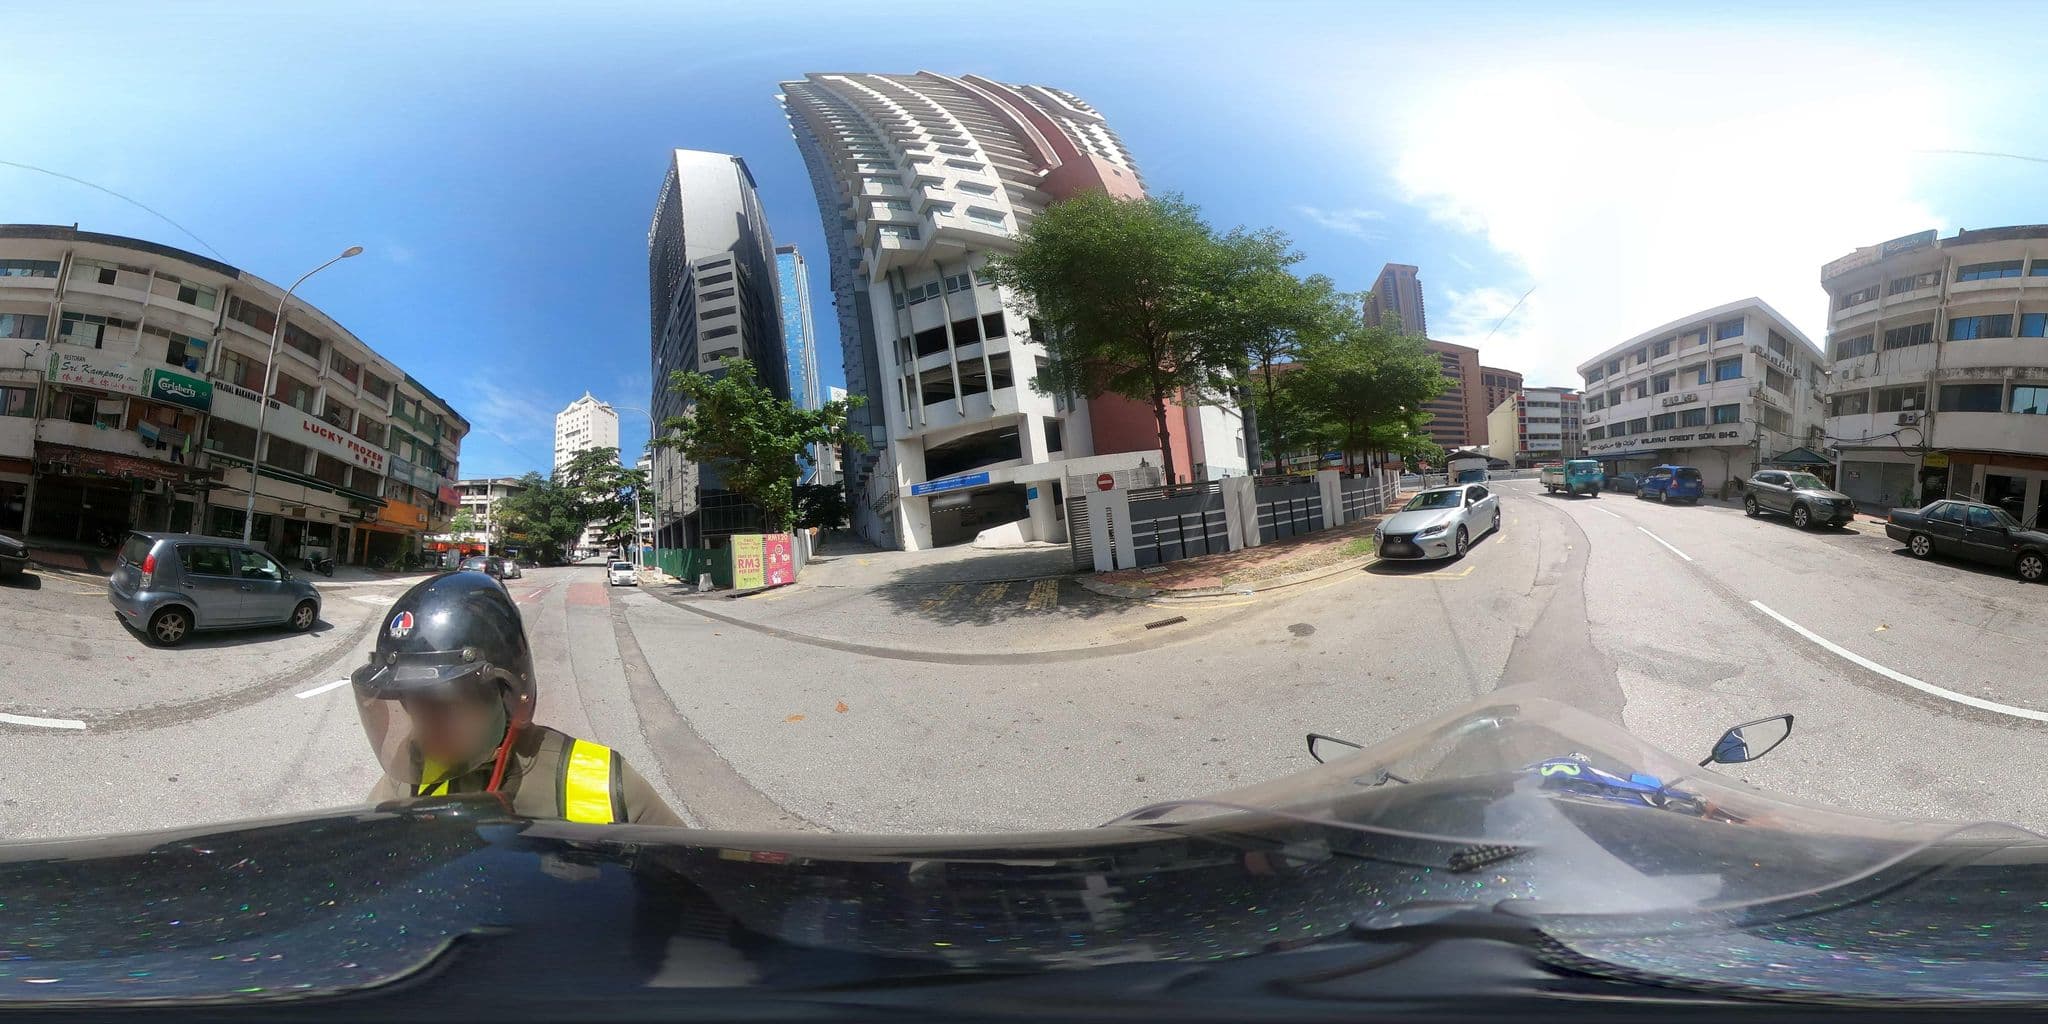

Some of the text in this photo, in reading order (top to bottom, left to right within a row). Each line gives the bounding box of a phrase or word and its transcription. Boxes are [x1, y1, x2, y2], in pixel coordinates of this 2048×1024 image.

[61, 362, 80, 372] Sri
[158, 377, 196, 397] Carlsberg
[215, 381, 234, 394] PENJUAL
[303, 420, 344, 445] LUCKY
[347, 439, 384, 463] FROZEN
[1640, 436, 1667, 445] WILAYAH
[1669, 434, 1695, 442] CREDIT
[1719, 430, 1739, 439] BHD.
